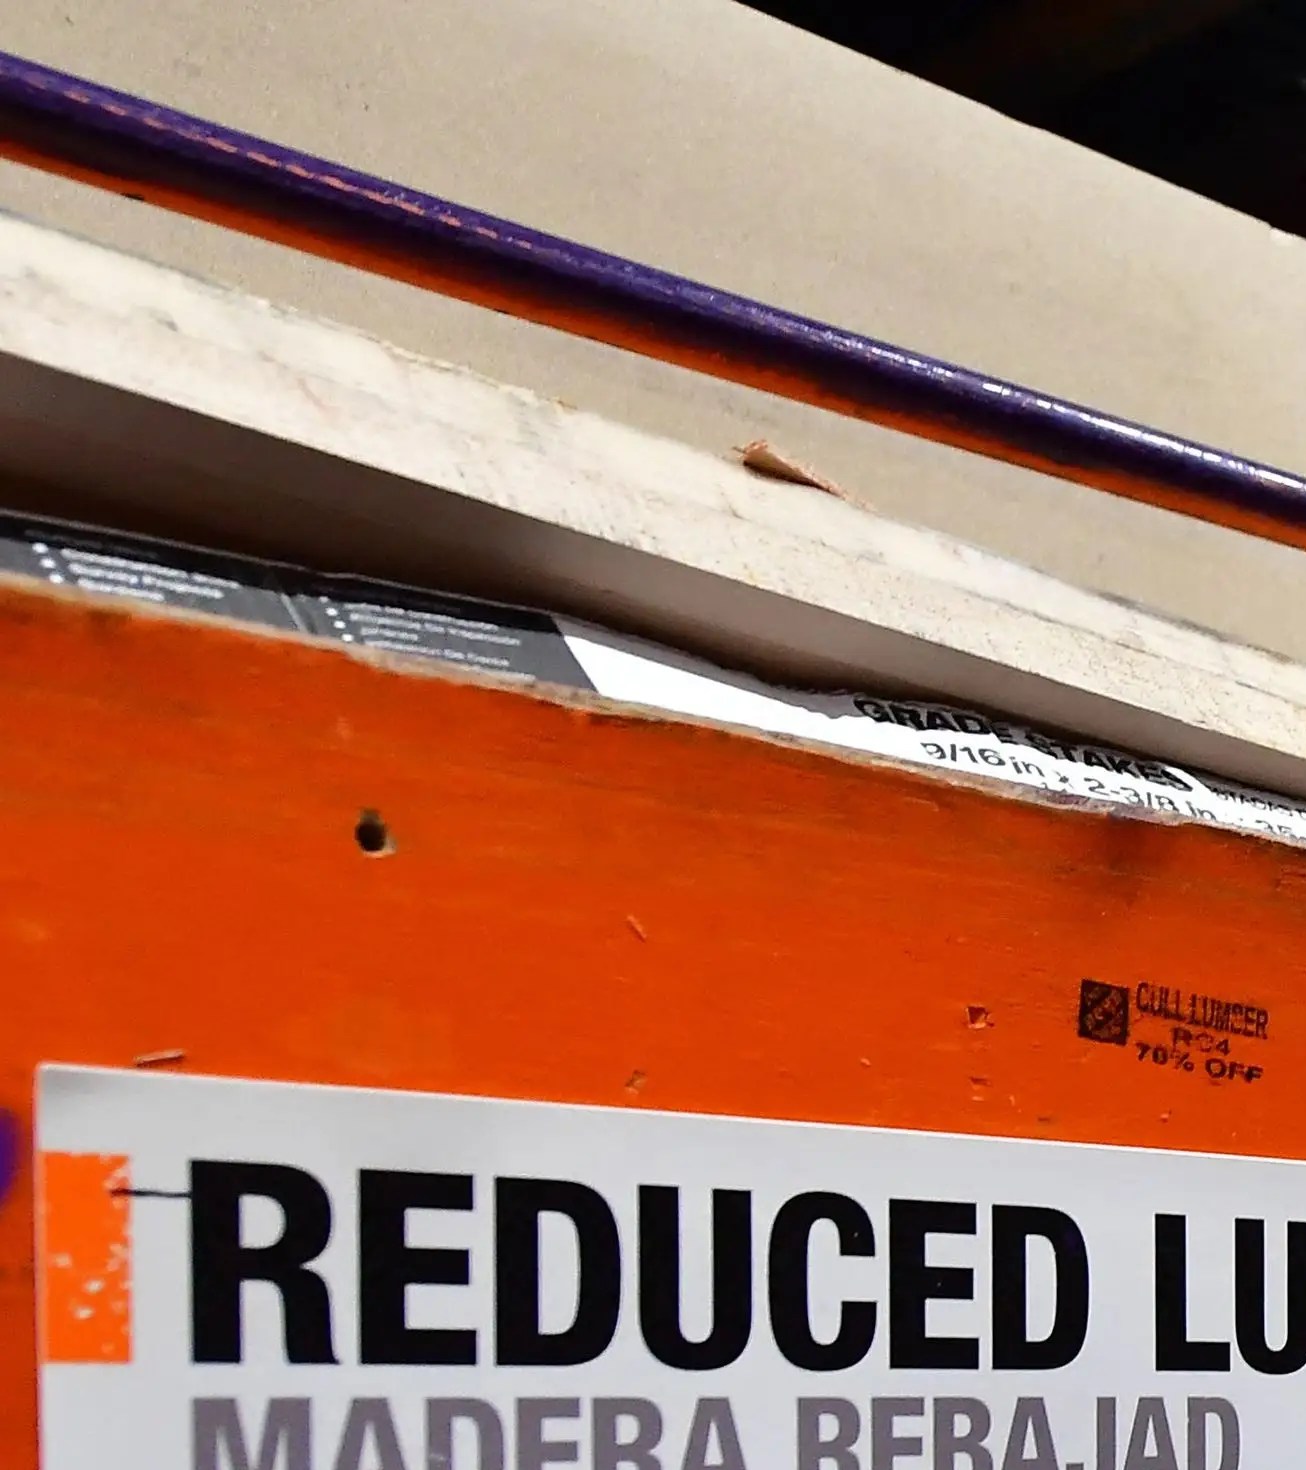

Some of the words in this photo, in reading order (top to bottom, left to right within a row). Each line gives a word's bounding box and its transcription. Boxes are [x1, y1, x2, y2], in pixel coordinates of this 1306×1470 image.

[853, 696, 1018, 744] GRADE
[1025, 730, 1193, 792] STAKES
[920, 742, 1006, 767] 9/16
[1009, 756, 1045, 777] in
[1135, 1042, 1195, 1072] 70%
[1205, 1058, 1264, 1083] OFF
[190, 1159, 1091, 1371] REDUCED
